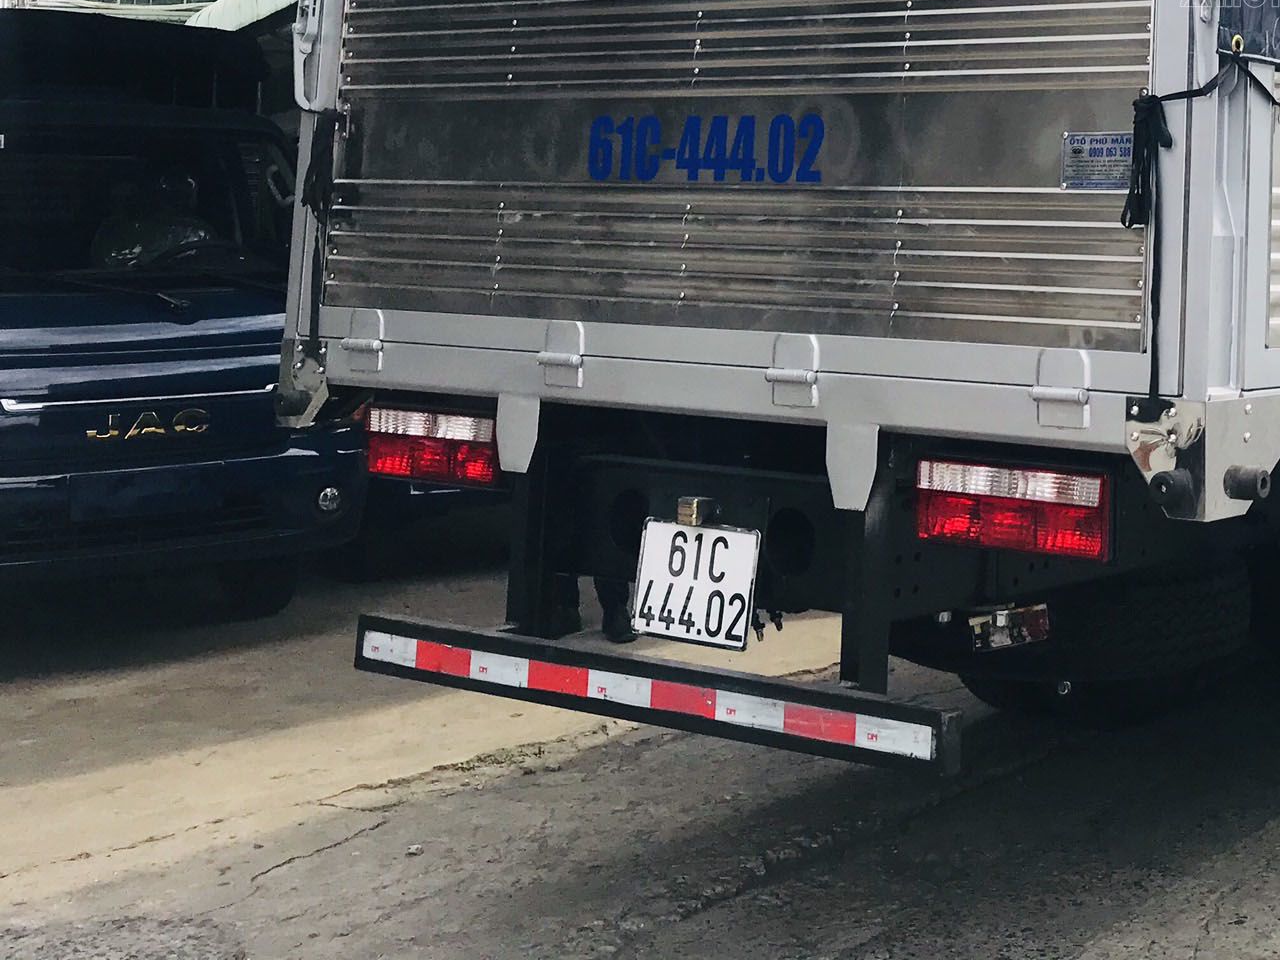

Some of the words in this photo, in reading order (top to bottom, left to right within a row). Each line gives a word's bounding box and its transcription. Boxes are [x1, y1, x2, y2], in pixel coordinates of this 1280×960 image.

[588, 113, 825, 183] 61C-444.02
[86, 408, 209, 440] JAC
[668, 530, 729, 583] 61C
[638, 579, 747, 642] 444.02
